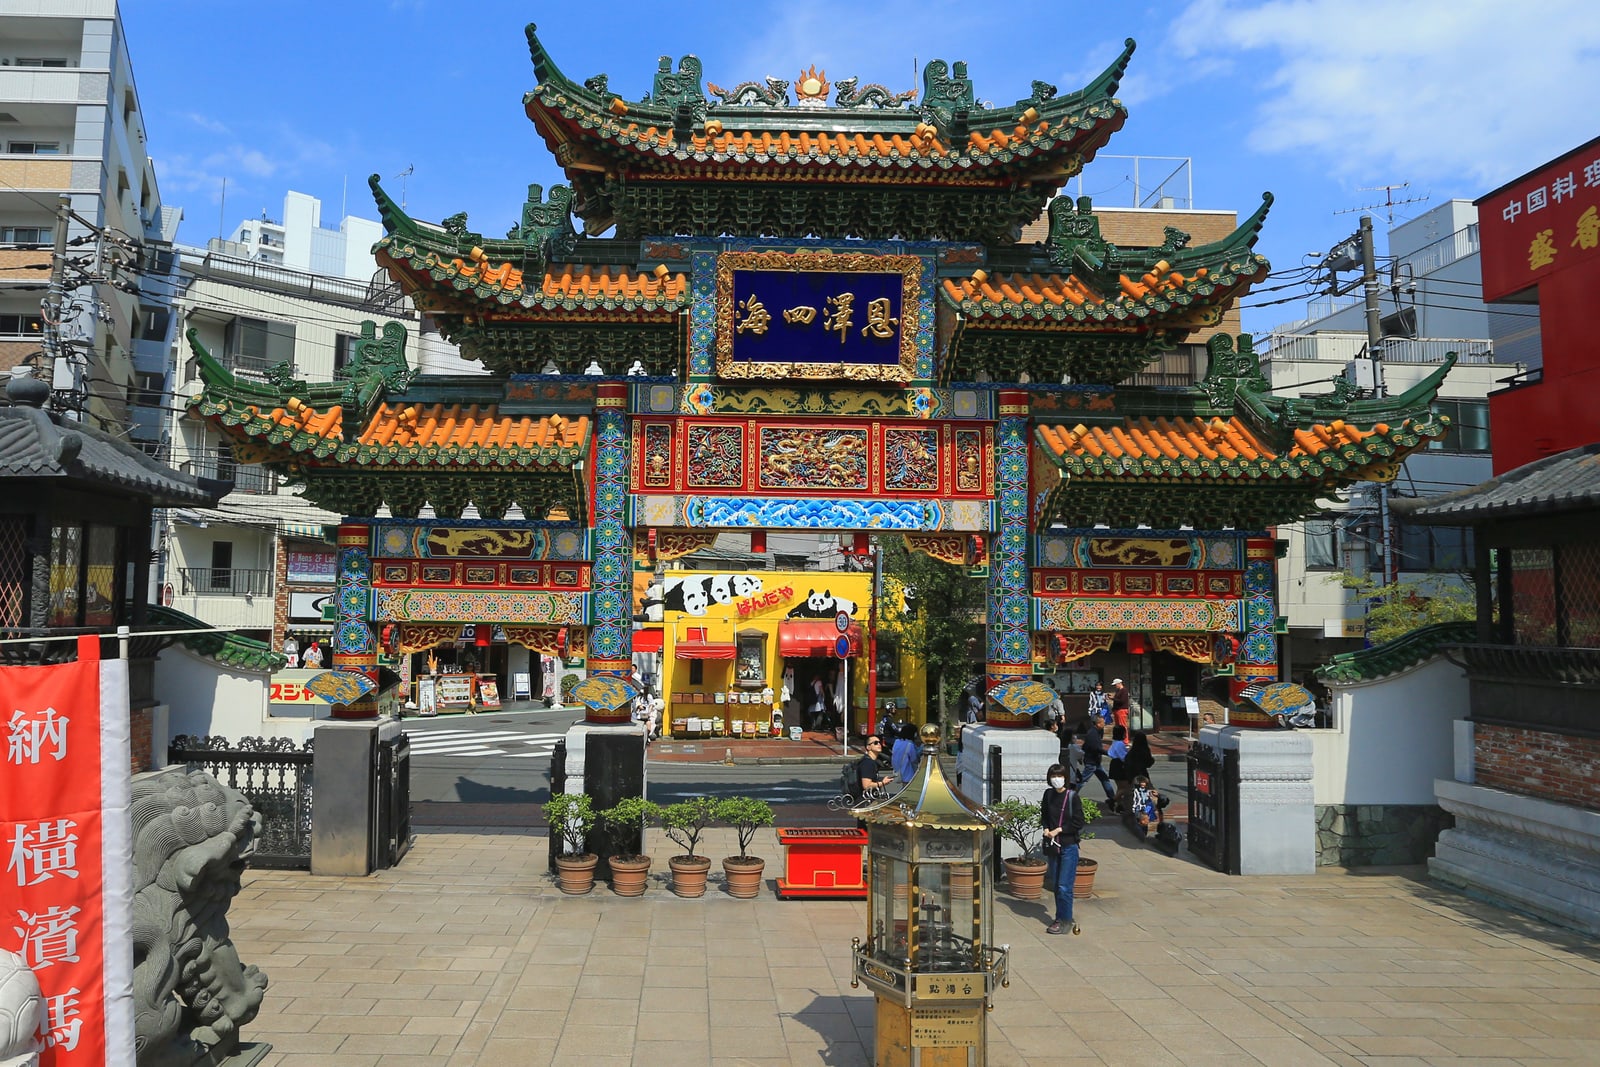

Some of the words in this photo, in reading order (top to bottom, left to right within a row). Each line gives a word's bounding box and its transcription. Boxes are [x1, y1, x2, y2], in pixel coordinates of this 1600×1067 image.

[1503, 159, 1600, 224] 中国料理
[838, 616, 847, 628] 30
[7, 707, 70, 765] 納
